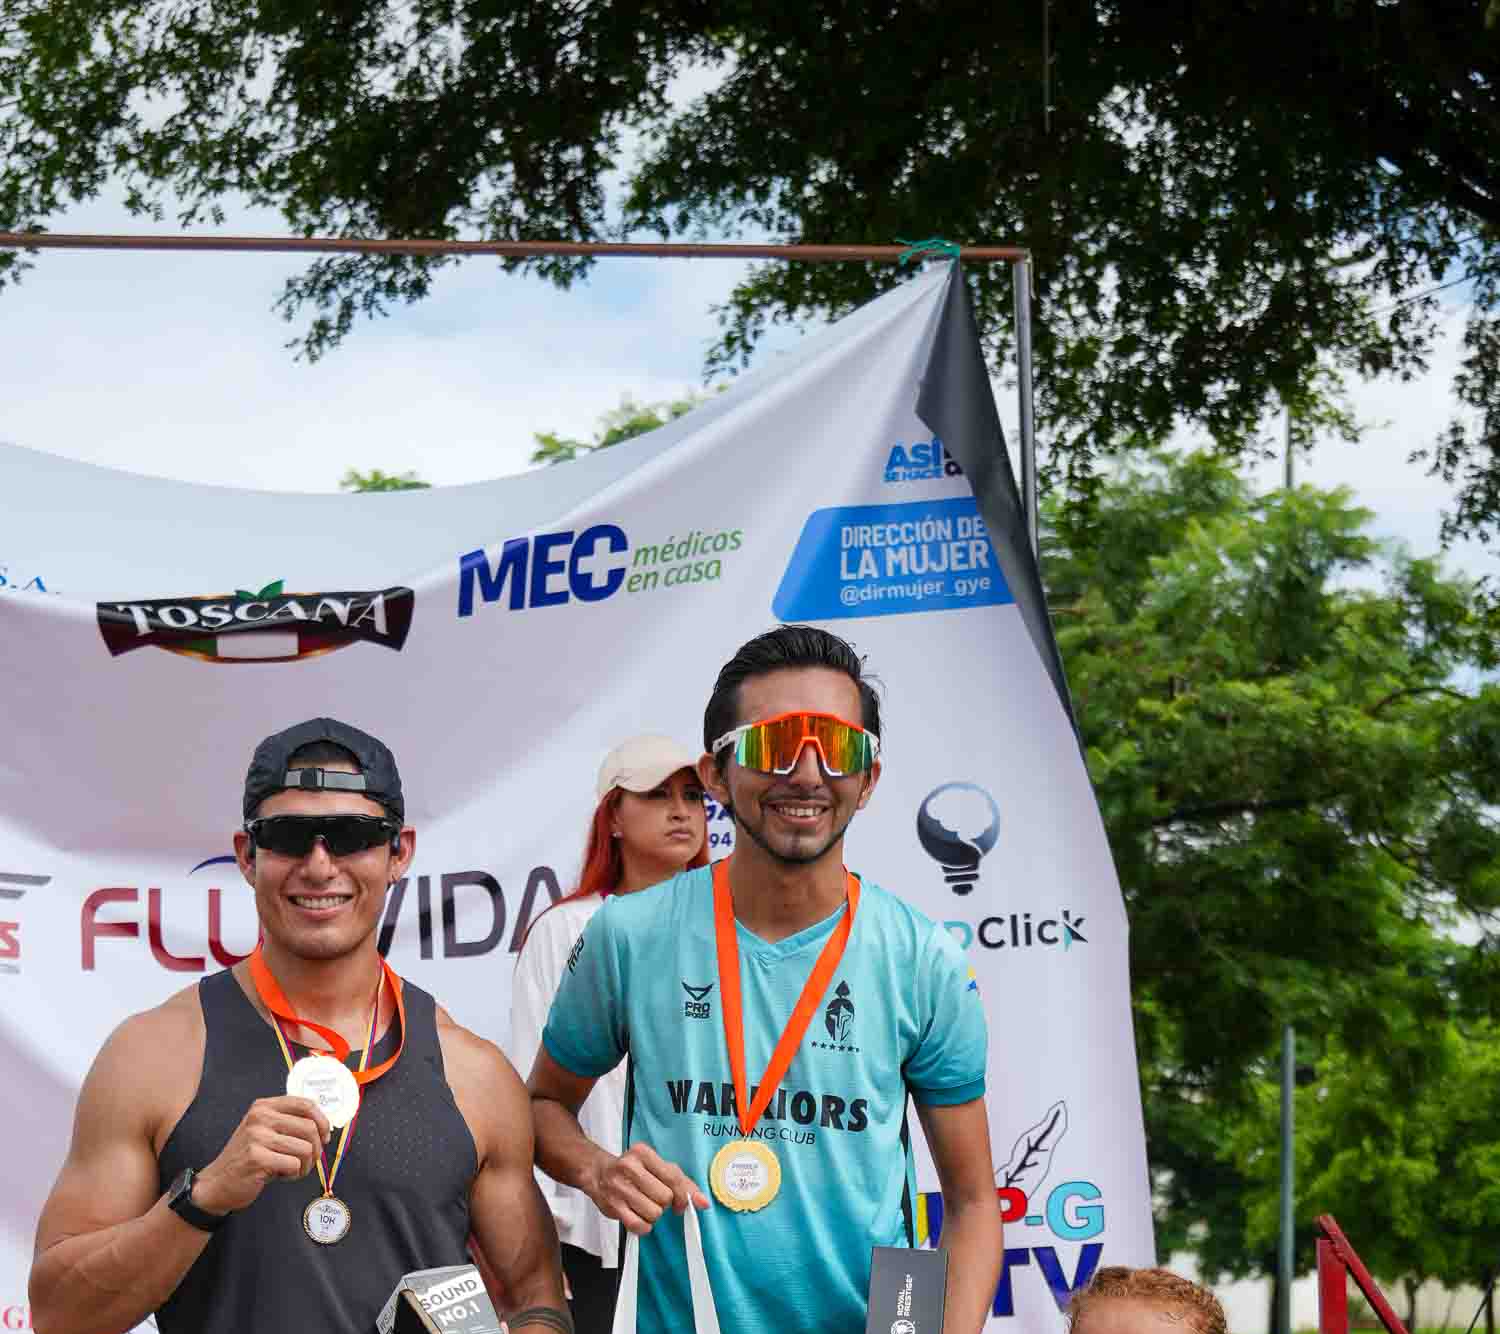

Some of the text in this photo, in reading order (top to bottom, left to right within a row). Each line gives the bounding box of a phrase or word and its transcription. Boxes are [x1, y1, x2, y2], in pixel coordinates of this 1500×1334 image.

[633, 530, 743, 567] médicos
[841, 514, 987, 550] DIRECCIÓN DE
[458, 524, 628, 617] MEC
[627, 559, 721, 592] en casa
[840, 540, 990, 580] LA MUJER
[840, 574, 992, 606] @dirmujer_gye
[117, 593, 390, 637] TOSCANA
[703, 1123, 816, 1145] RUNNNG CLUB
[420, 1279, 478, 1311] SOUND
